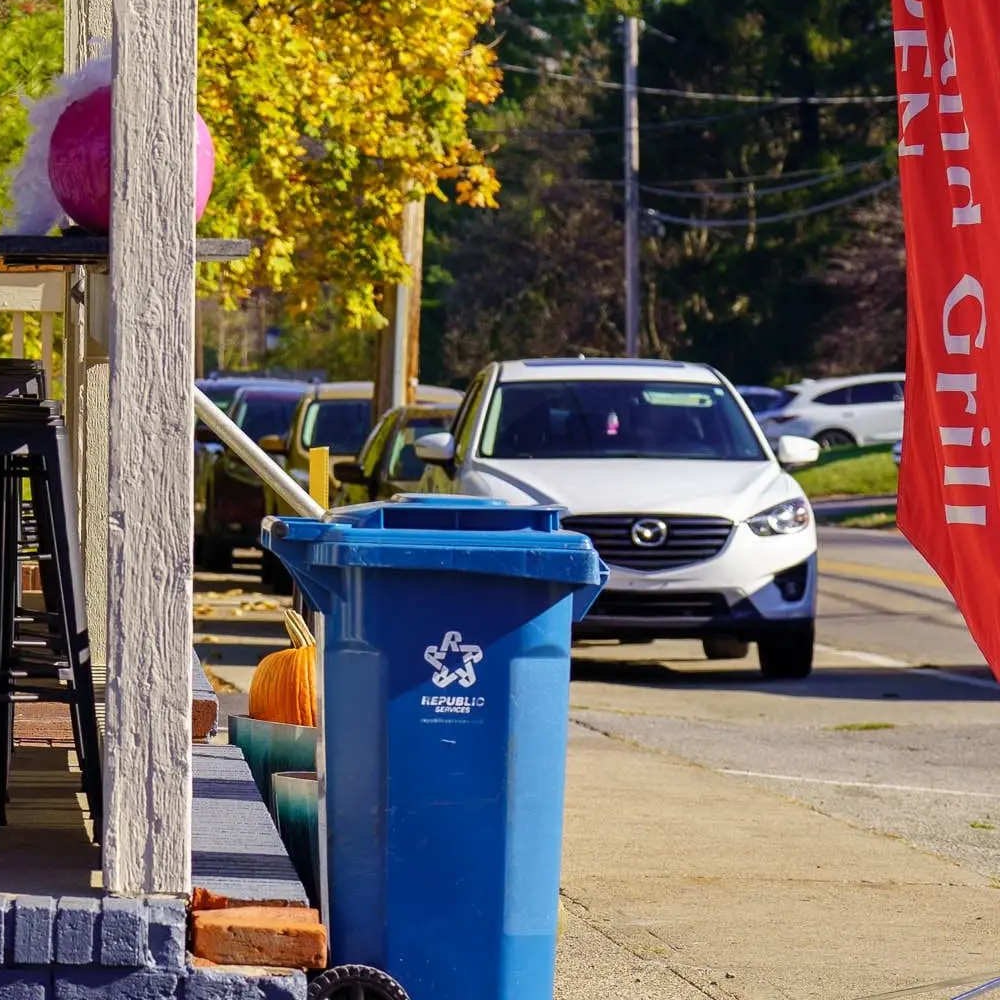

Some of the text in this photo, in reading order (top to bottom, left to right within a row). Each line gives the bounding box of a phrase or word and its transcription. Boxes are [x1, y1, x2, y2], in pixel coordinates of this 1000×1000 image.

[935, 273, 991, 527] Grill
[421, 695, 486, 707] REPUBLIC
[435, 706, 471, 714] SERVICES
